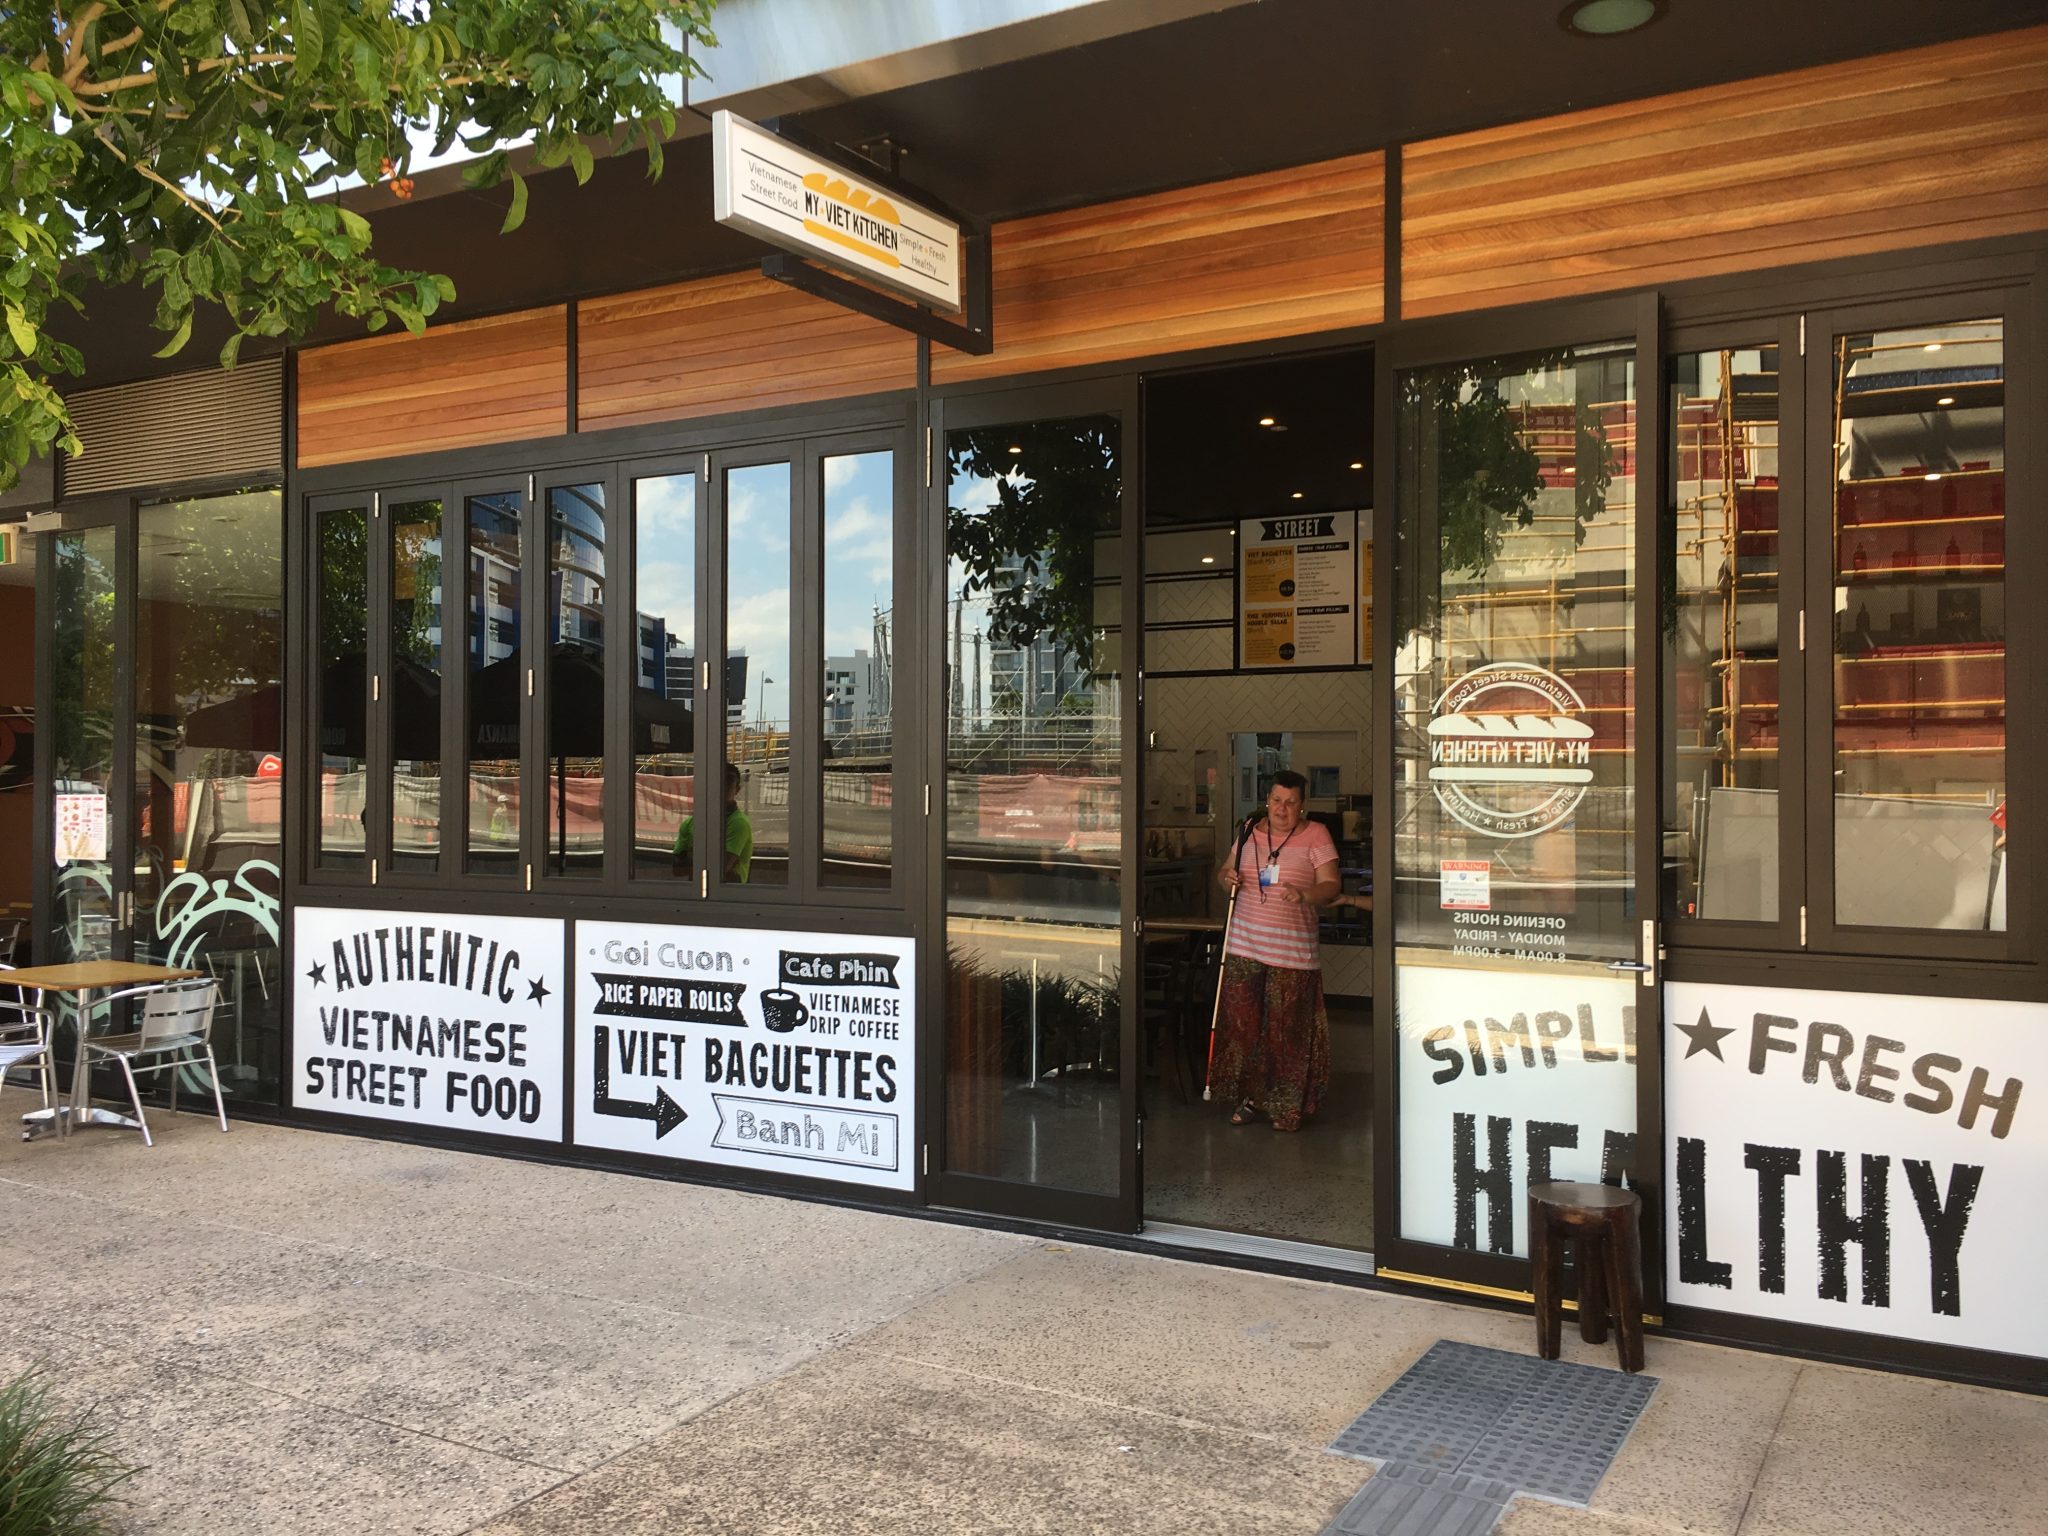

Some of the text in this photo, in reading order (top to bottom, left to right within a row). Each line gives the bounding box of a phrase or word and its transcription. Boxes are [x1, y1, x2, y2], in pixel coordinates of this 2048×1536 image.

[748, 159, 798, 193] Vietnamese
[750, 179, 798, 210] Street Food
[804, 190, 819, 217] MY
[825, 202, 851, 235] VIET
[900, 232, 946, 262] Simple Fresh
[911, 254, 937, 276] Healthy
[1274, 518, 1320, 539] STREET
[1443, 862, 1487, 871] WARNING
[332, 926, 520, 1003] AUTHENTIC
[603, 940, 733, 972] Goi Cuon
[839, 959, 890, 983] Phin
[603, 982, 734, 1014] RICE PAPER ROLLS
[809, 992, 900, 1017] VIETNAMESE
[319, 1005, 527, 1067] VIETNAMESE
[810, 1015, 900, 1040] DRIP COFFEE
[618, 1029, 898, 1103] VIET BAGUETTES
[1748, 1012, 2023, 1139] FRESH
[306, 1056, 541, 1123] STREET FOOD
[736, 1109, 880, 1156] Banh Mi
